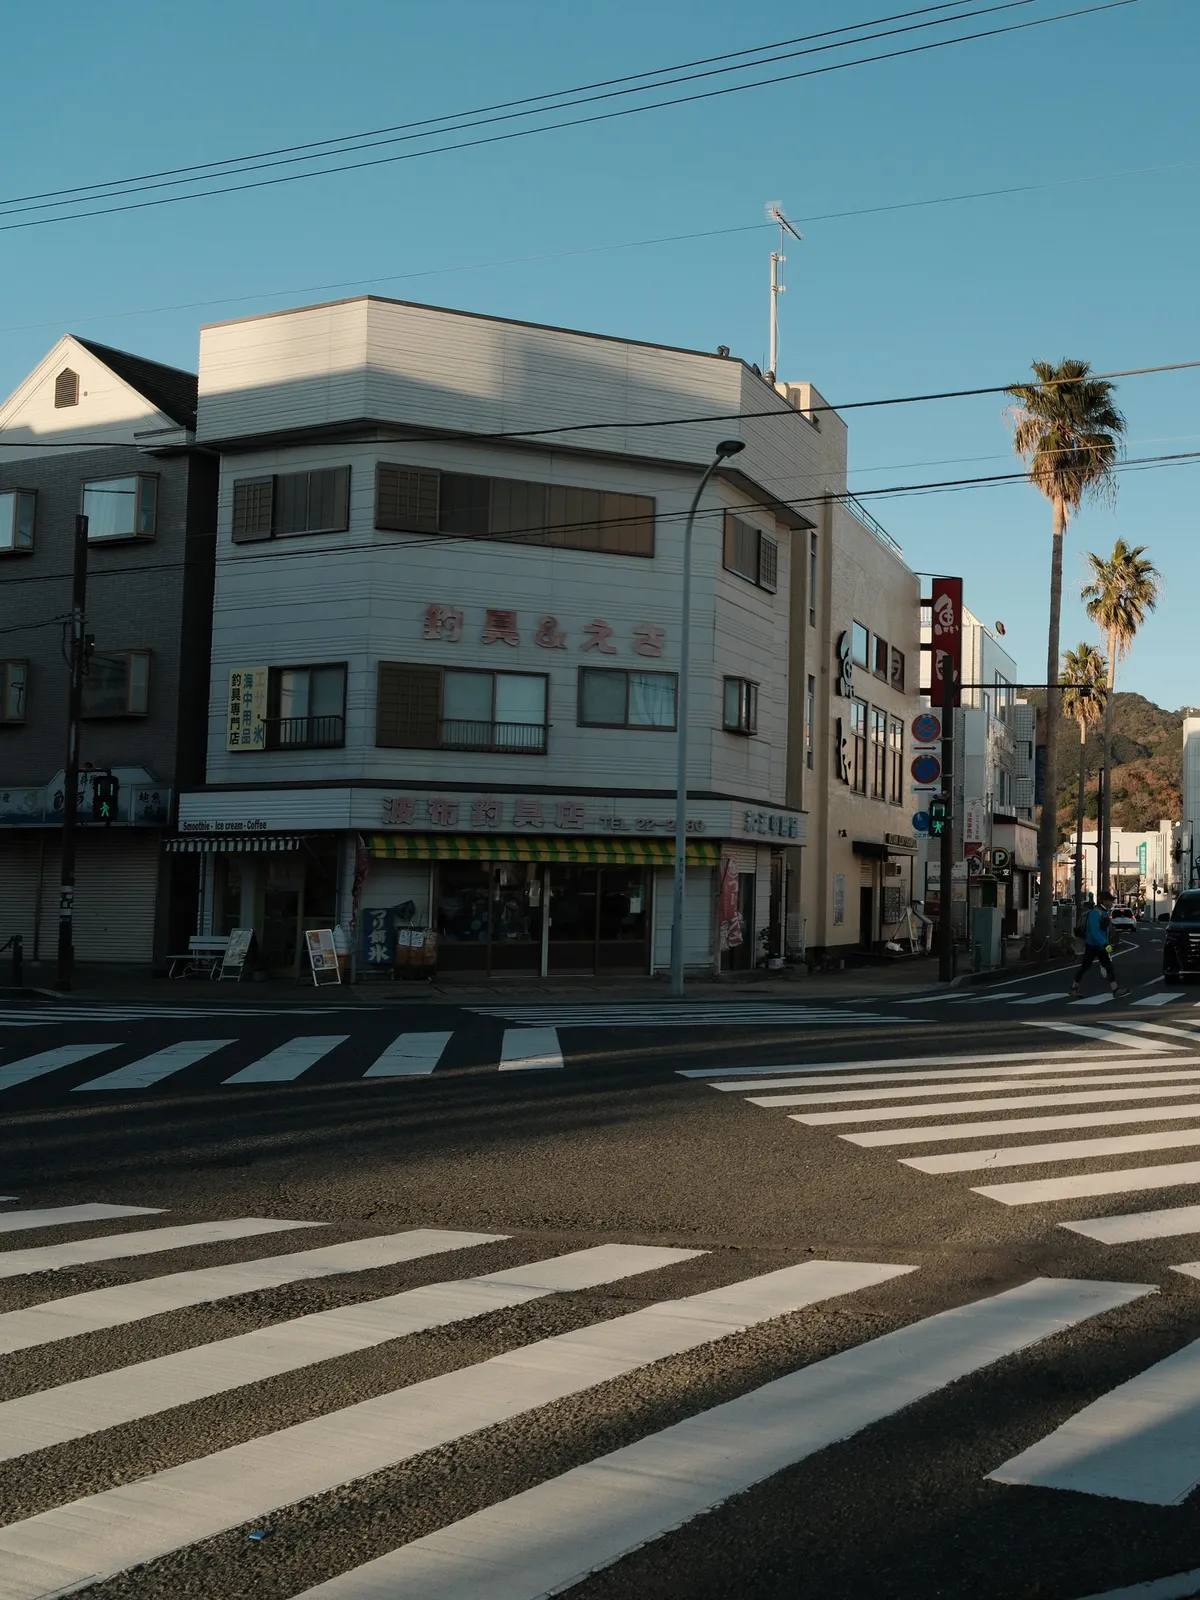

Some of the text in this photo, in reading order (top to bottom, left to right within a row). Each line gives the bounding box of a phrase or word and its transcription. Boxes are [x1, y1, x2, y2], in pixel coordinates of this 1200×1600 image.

[423, 603, 666, 658] 釣具&えさ
[229, 674, 242, 745] 釣具専門店
[241, 674, 254, 744] 海中用品
[183, 819, 267, 831] Smoothie Ice cream Coffee
[382, 797, 585, 829] 波布釣具店
[600, 816, 704, 833] TEL 22-280
[995, 852, 1006, 864] P
